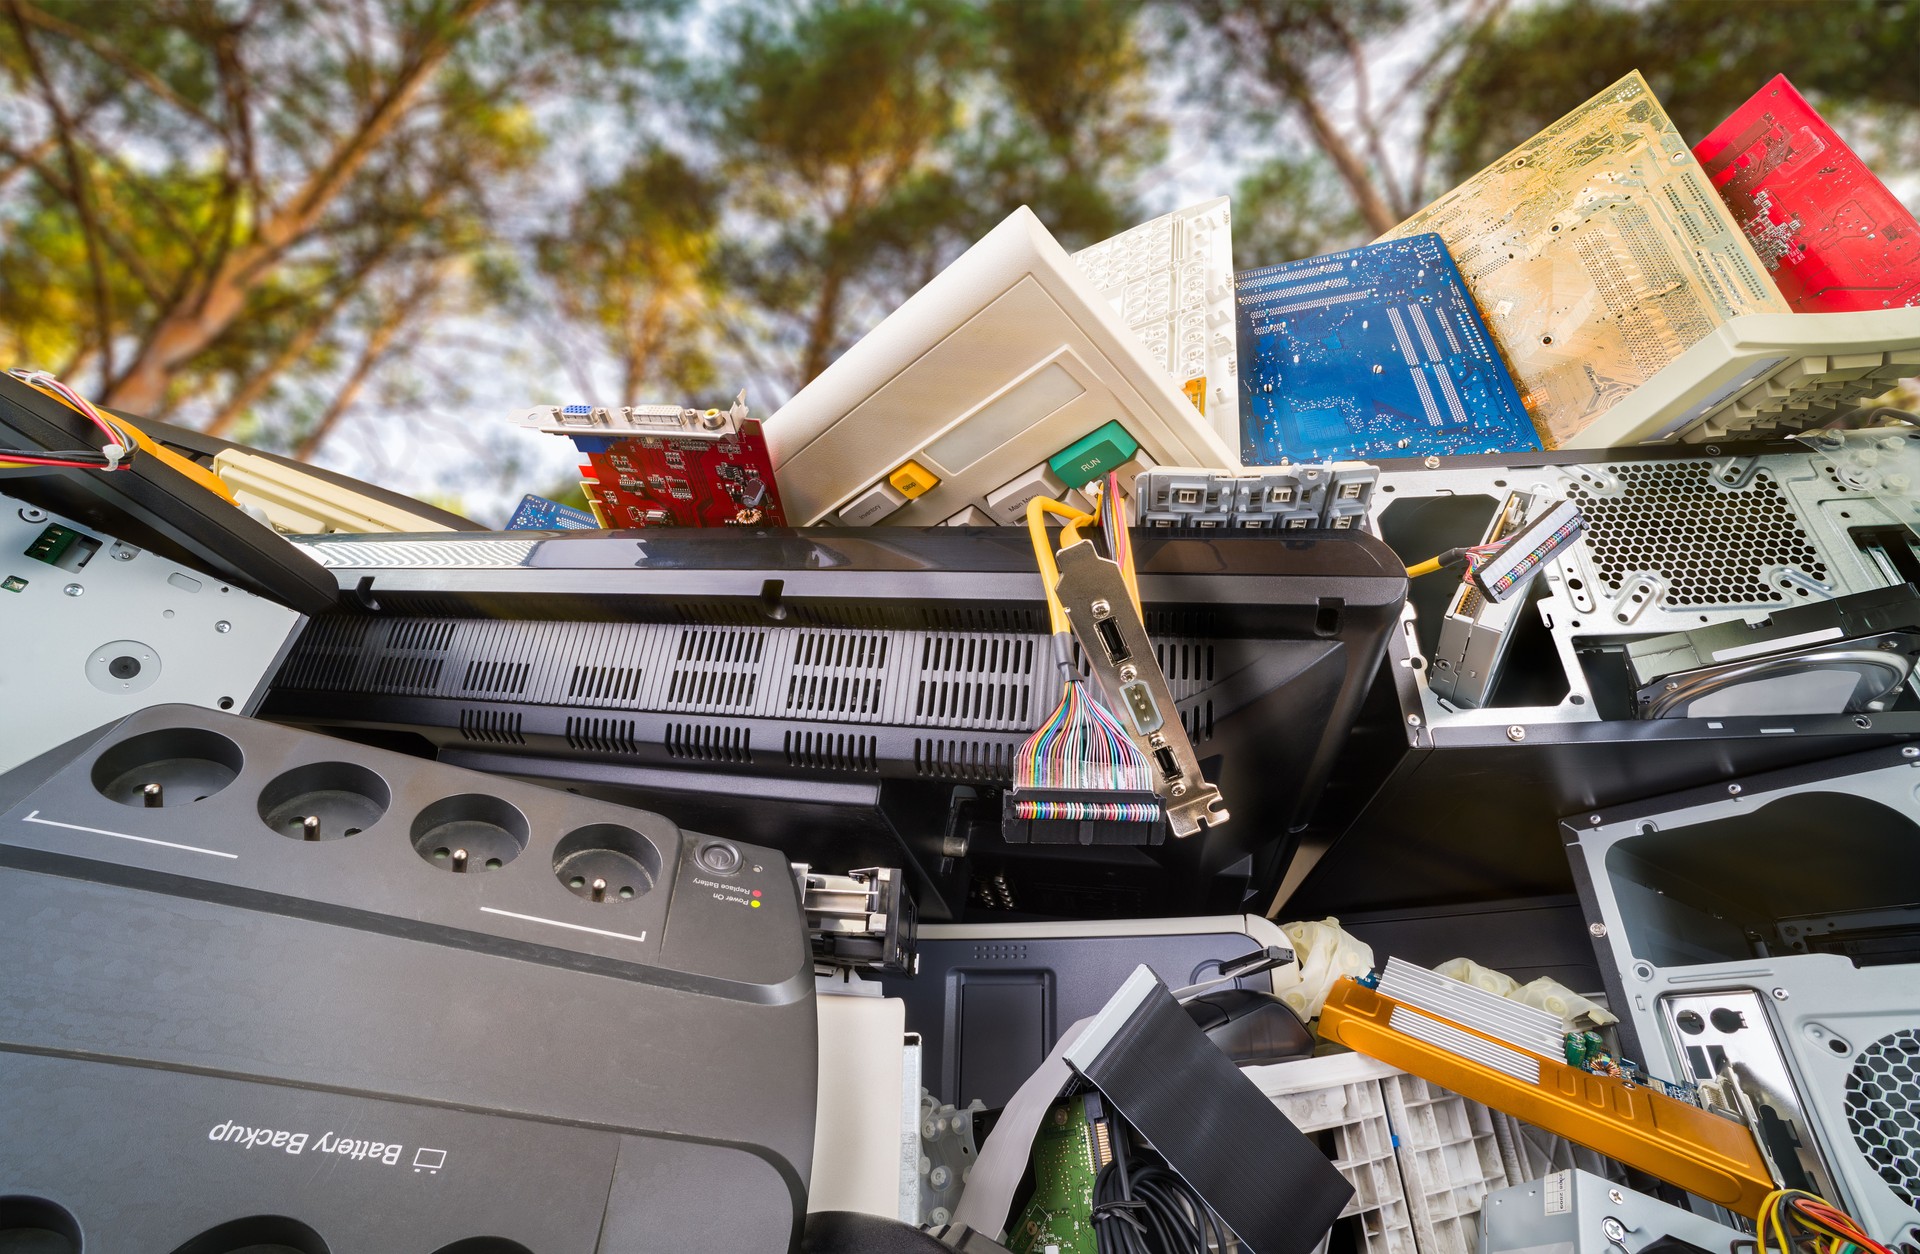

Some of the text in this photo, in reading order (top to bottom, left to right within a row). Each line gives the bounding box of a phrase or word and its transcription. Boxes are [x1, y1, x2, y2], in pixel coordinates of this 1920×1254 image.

[1080, 457, 1101, 472] RUN
[902, 481, 917, 492] Stop
[858, 504, 882, 519] Inventory
[1007, 501, 1023, 513] Main
[692, 877, 751, 895] Replace Battery
[712, 892, 749, 906] Power On
[208, 1119, 403, 1166] Battery Backup
